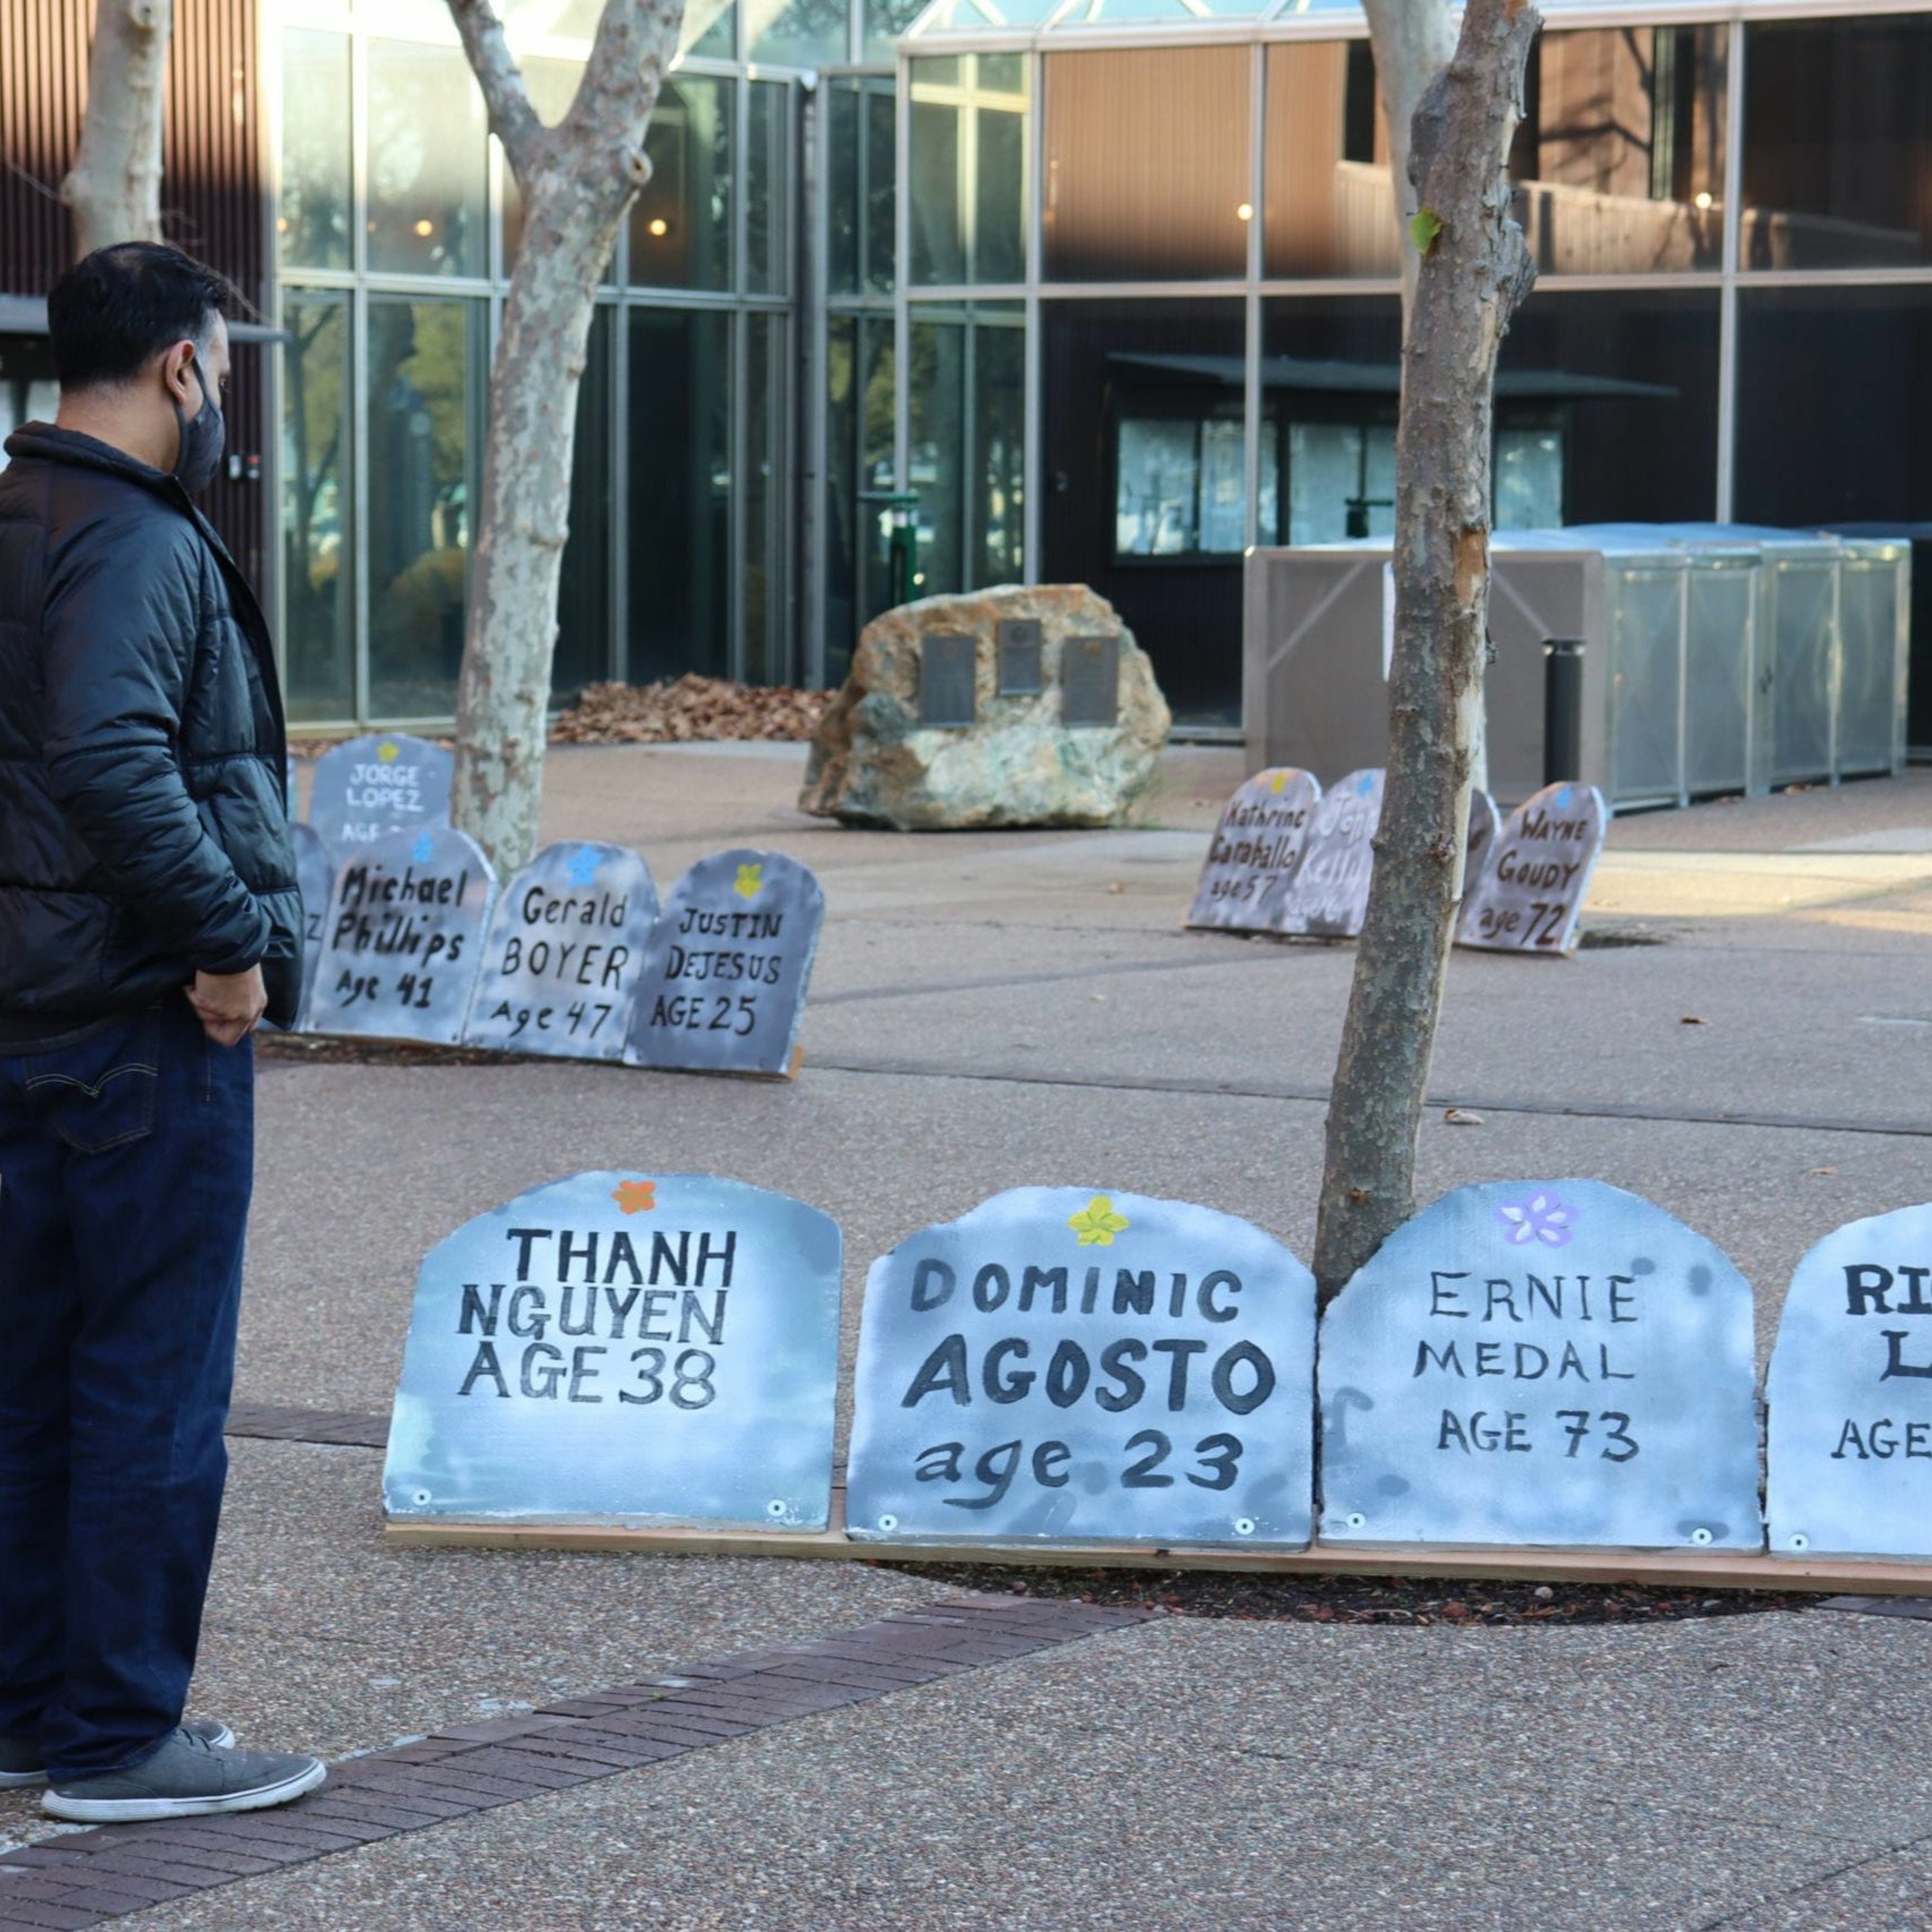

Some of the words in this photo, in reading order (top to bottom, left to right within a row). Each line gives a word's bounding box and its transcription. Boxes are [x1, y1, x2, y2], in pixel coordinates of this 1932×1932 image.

[349, 764, 421, 788] JORGE
[345, 786, 426, 812] LOPEZ
[1520, 809, 1589, 841] WAYNE
[339, 866, 468, 907] Michael
[1210, 879, 1242, 902] age
[1240, 875, 1278, 905] 57
[1497, 848, 1581, 891] GOUDY
[522, 886, 628, 927] Gerald
[679, 907, 783, 939] JUSTIN
[1479, 907, 1520, 940] age
[1520, 902, 1566, 946] 72
[332, 912, 465, 967] Phillips
[500, 937, 629, 990] BOYER
[665, 945, 782, 985] DEJESUS
[335, 969, 380, 1007] Age
[395, 973, 433, 1009] 41
[489, 1000, 554, 1038] Age
[566, 1001, 612, 1039] 47
[650, 995, 705, 1029] AGE
[708, 996, 757, 1036] 25
[507, 1228, 737, 1287] THANH
[910, 1258, 1243, 1323] DOMINIC
[1428, 1271, 1639, 1323] ERNIE
[1842, 1264, 1932, 1316] RI
[455, 1283, 728, 1345] NGUYEN
[457, 1340, 608, 1403] AGE
[619, 1347, 716, 1410] 38
[900, 1333, 1276, 1415] AGOSTO
[1412, 1340, 1636, 1383] MEDAL
[1879, 1330, 1932, 1383] L
[1435, 1408, 1533, 1455] AGE
[1555, 1410, 1640, 1463] 73
[1830, 1418, 1932, 1461] AGE
[914, 1439, 1072, 1510] age
[1120, 1428, 1244, 1492] 23
